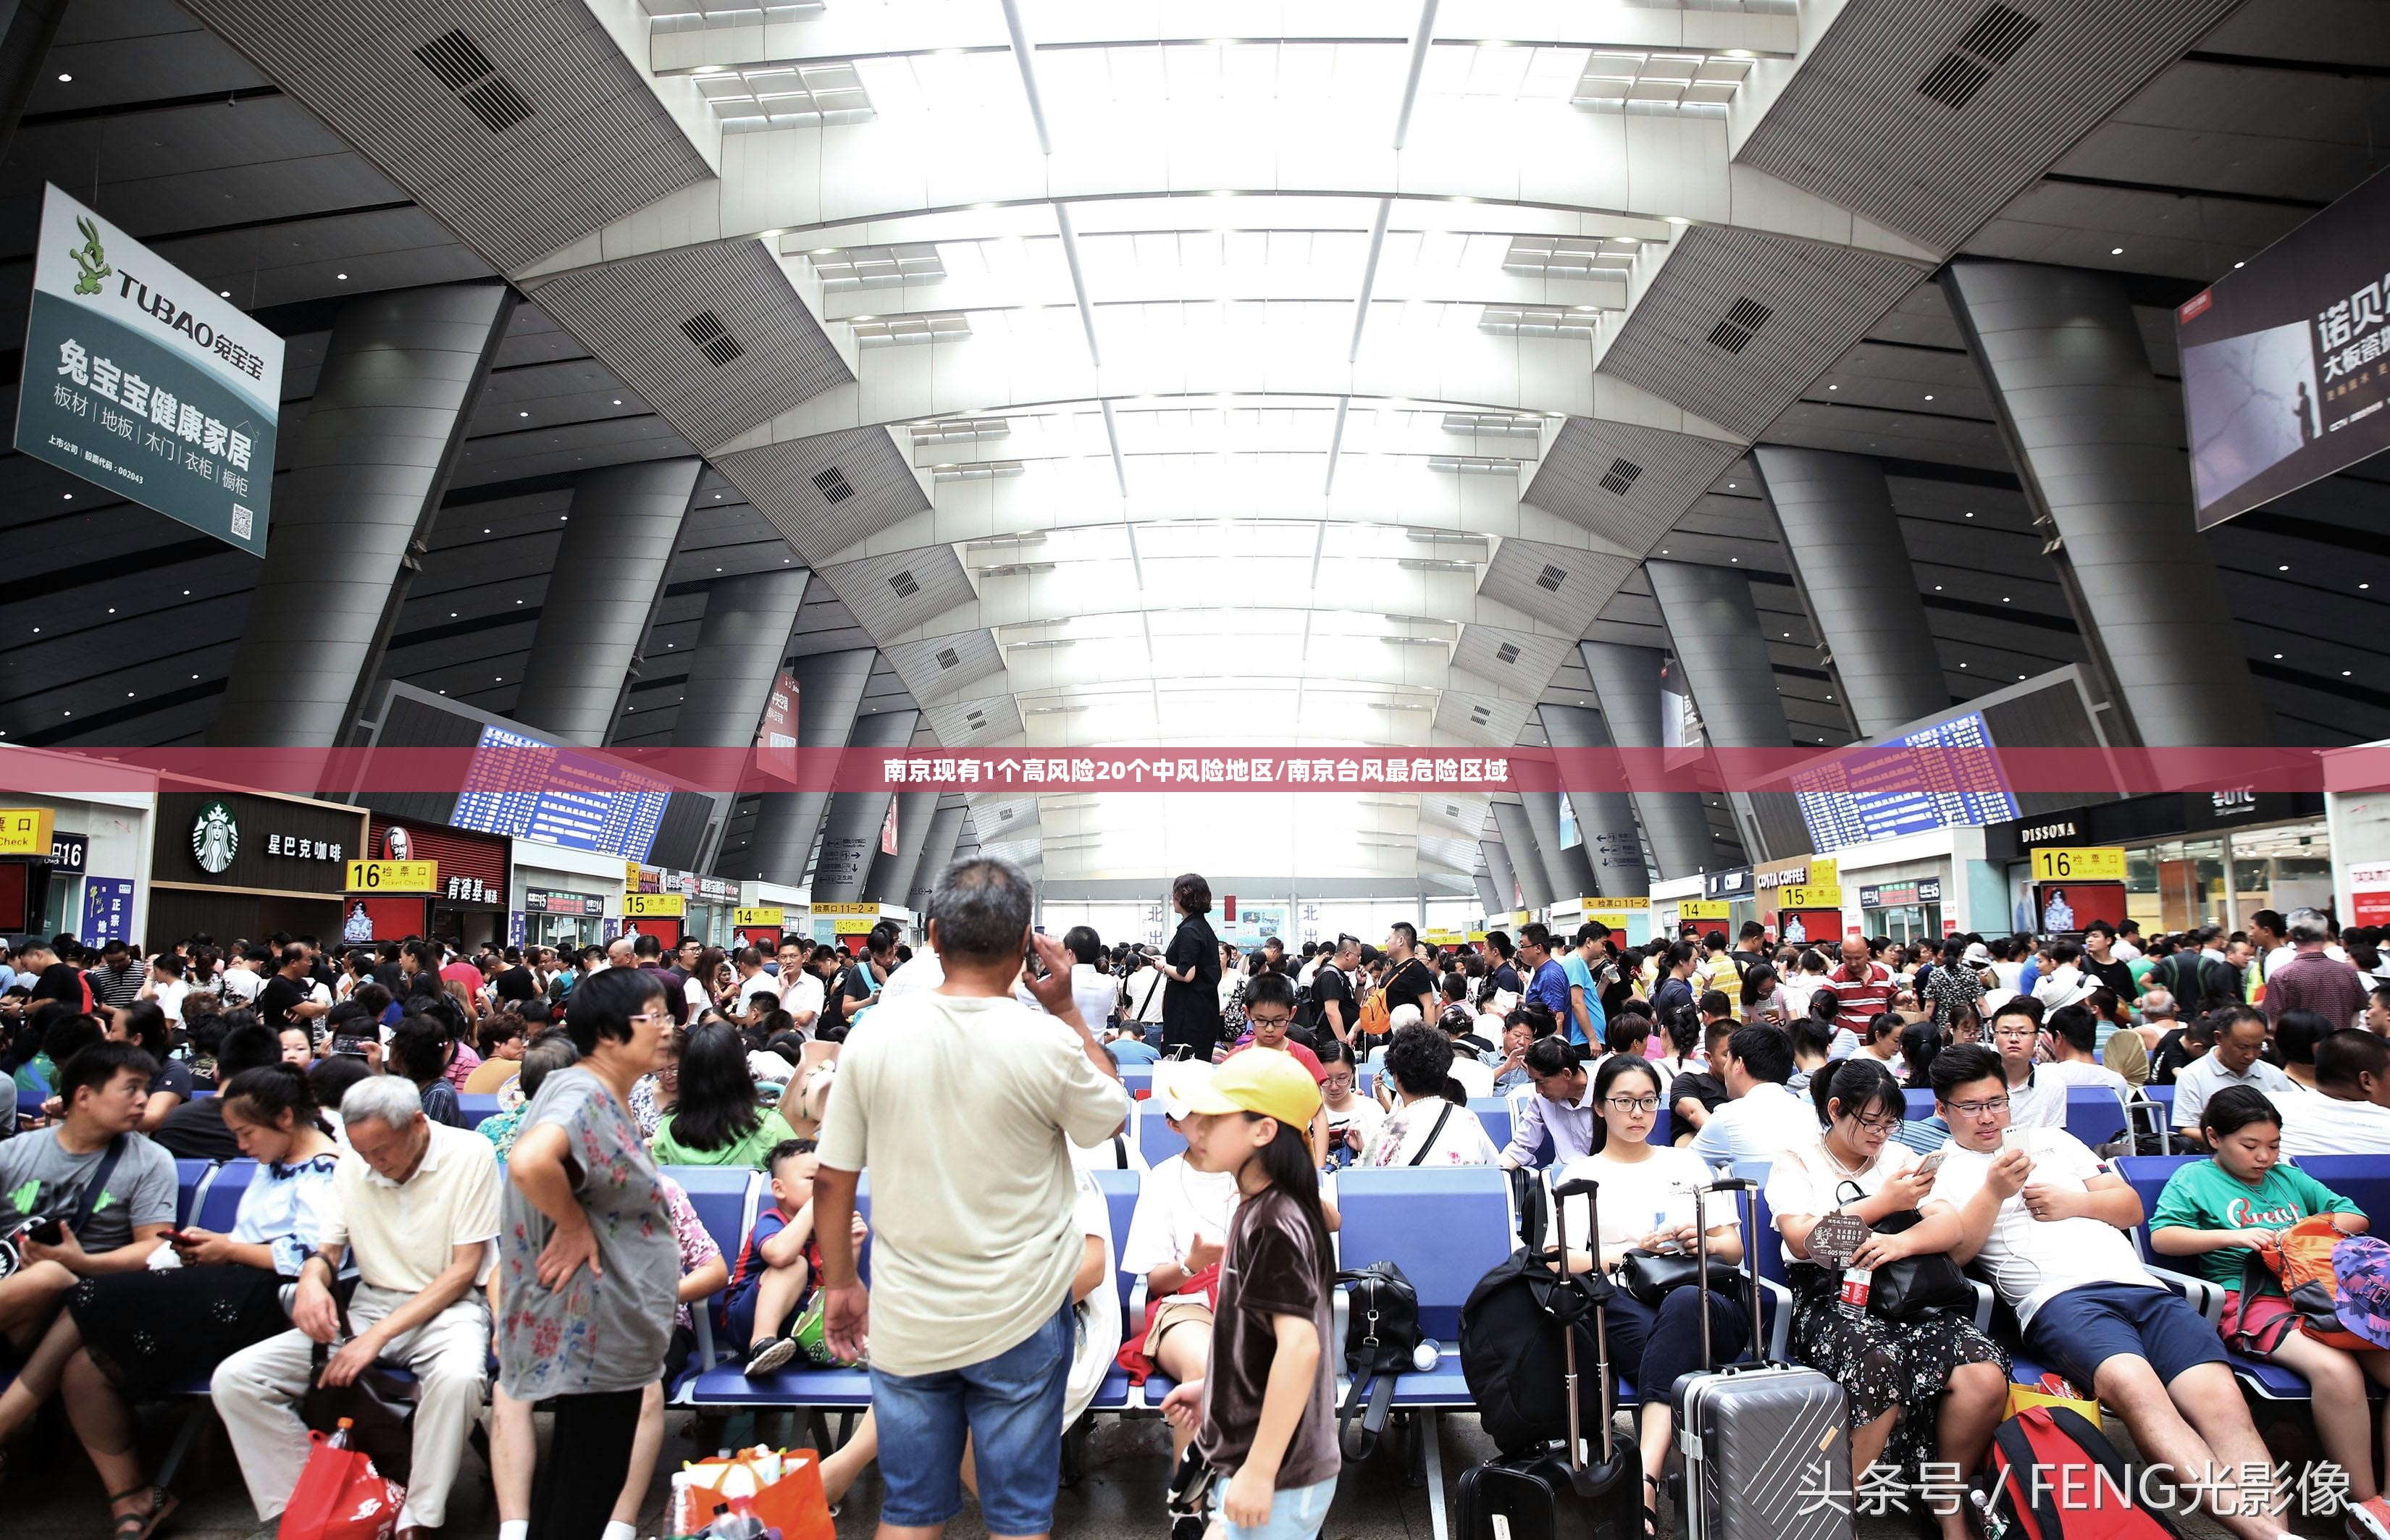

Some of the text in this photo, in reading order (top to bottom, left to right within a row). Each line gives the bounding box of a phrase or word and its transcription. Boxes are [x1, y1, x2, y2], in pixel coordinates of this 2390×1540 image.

[2318, 272, 2390, 353] 诺贝
[117, 269, 264, 381] TUBAO 兔宝宝
[57, 338, 253, 472] 兔宝宝健康家居
[48, 434, 78, 455] 上市公司
[54, 382, 248, 497] 板材 地板 木门 衣柜 橱柜
[2021, 822, 2076, 843] DISSONA
[268, 833, 341, 862] 星巴克咖啡
[353, 864, 427, 888] 16 检票口
[2043, 852, 2118, 877] 16 检票口
[1756, 874, 1778, 888] COSTA
[1779, 867, 1806, 884] COFFEE
[448, 876, 498, 904] 肯德基 精选
[1785, 888, 1805, 906] 15
[626, 896, 645, 913] 15
[1684, 904, 1699, 917] 14
[737, 910, 752, 924] 14
